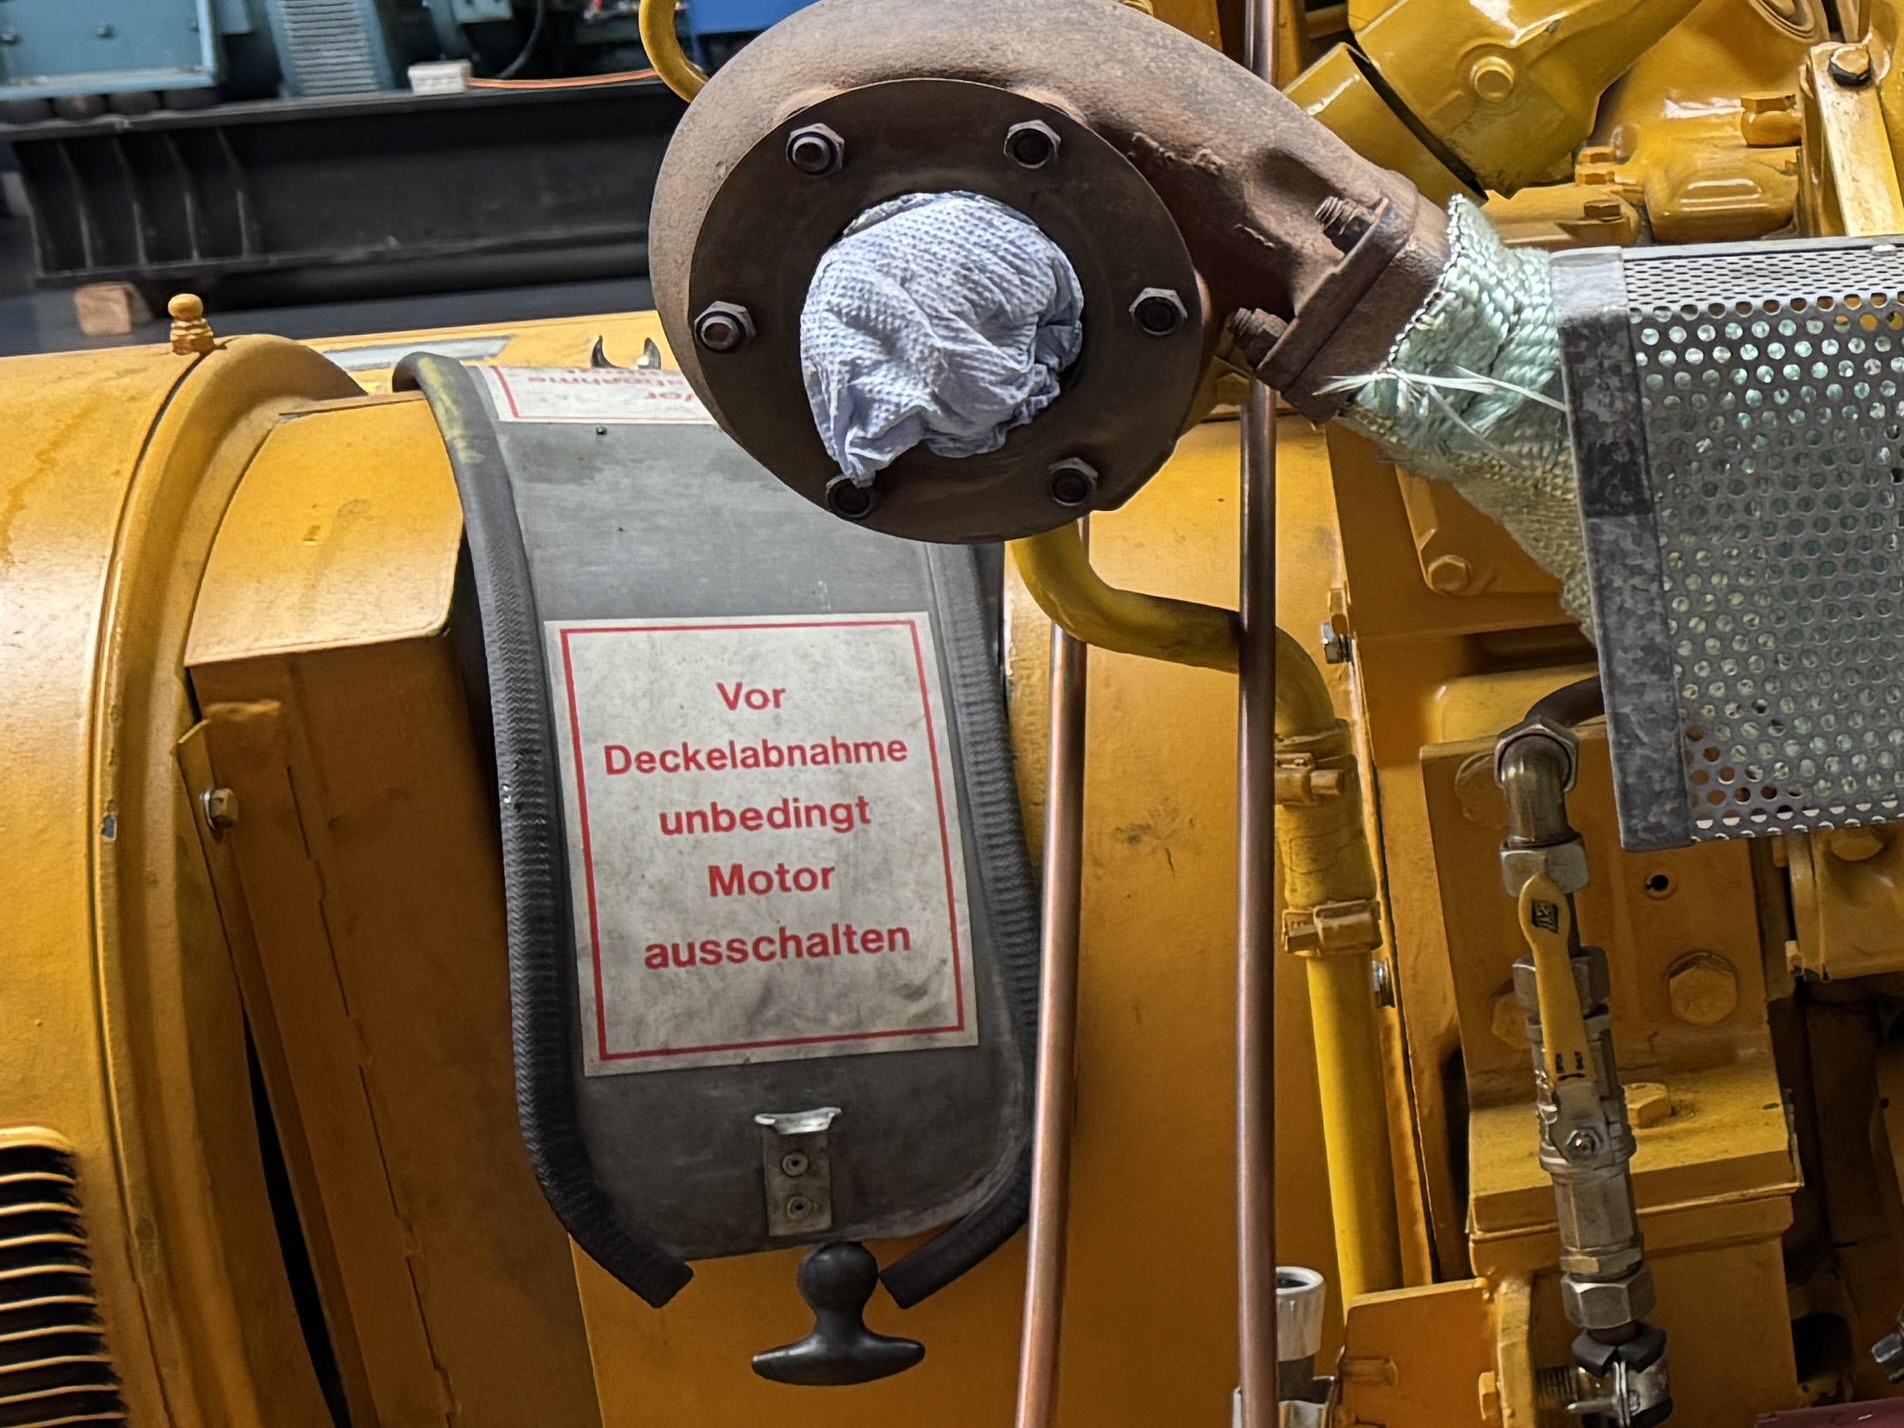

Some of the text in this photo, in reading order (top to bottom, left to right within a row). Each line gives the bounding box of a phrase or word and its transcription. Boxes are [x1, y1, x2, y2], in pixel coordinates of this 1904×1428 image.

[716, 682, 786, 711] Vor
[604, 735, 908, 776] Deckelabnahme
[659, 795, 871, 836] unbedingt
[708, 862, 835, 898] Motor
[644, 923, 911, 970] ausschalten
